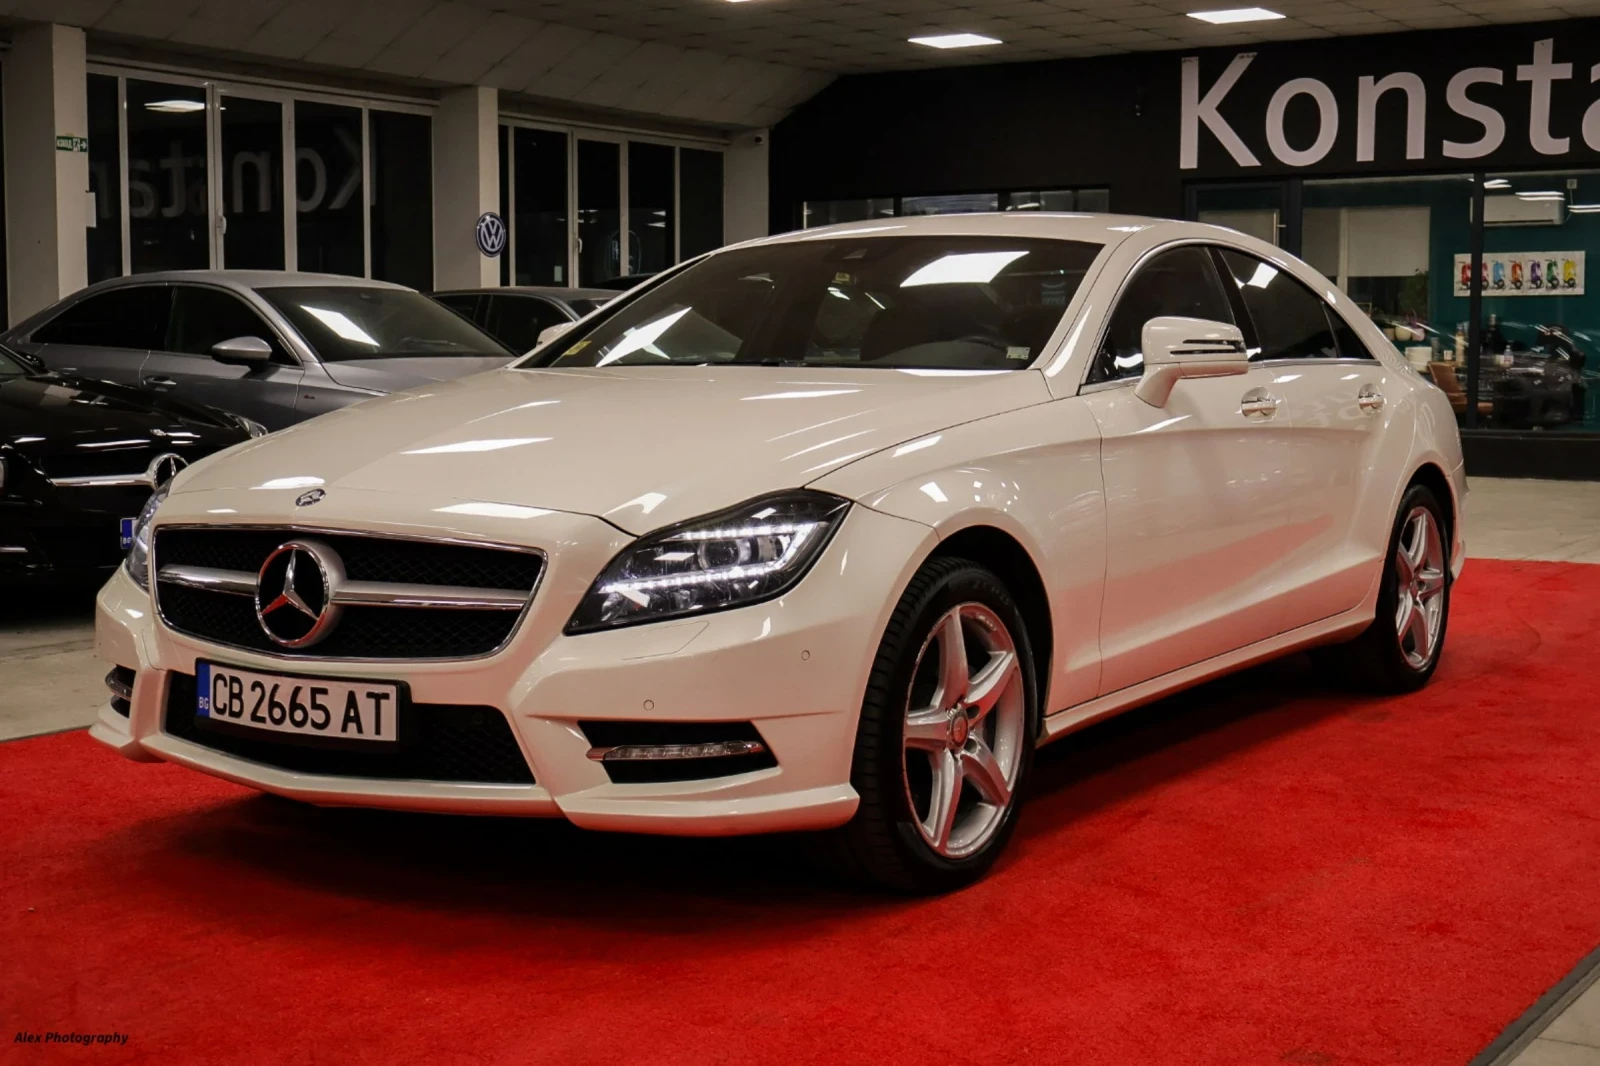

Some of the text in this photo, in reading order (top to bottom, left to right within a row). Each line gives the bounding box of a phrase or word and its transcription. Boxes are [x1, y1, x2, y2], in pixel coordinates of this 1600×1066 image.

[199, 696, 209, 710] BG
[213, 673, 390, 736] CB 2665 AT
